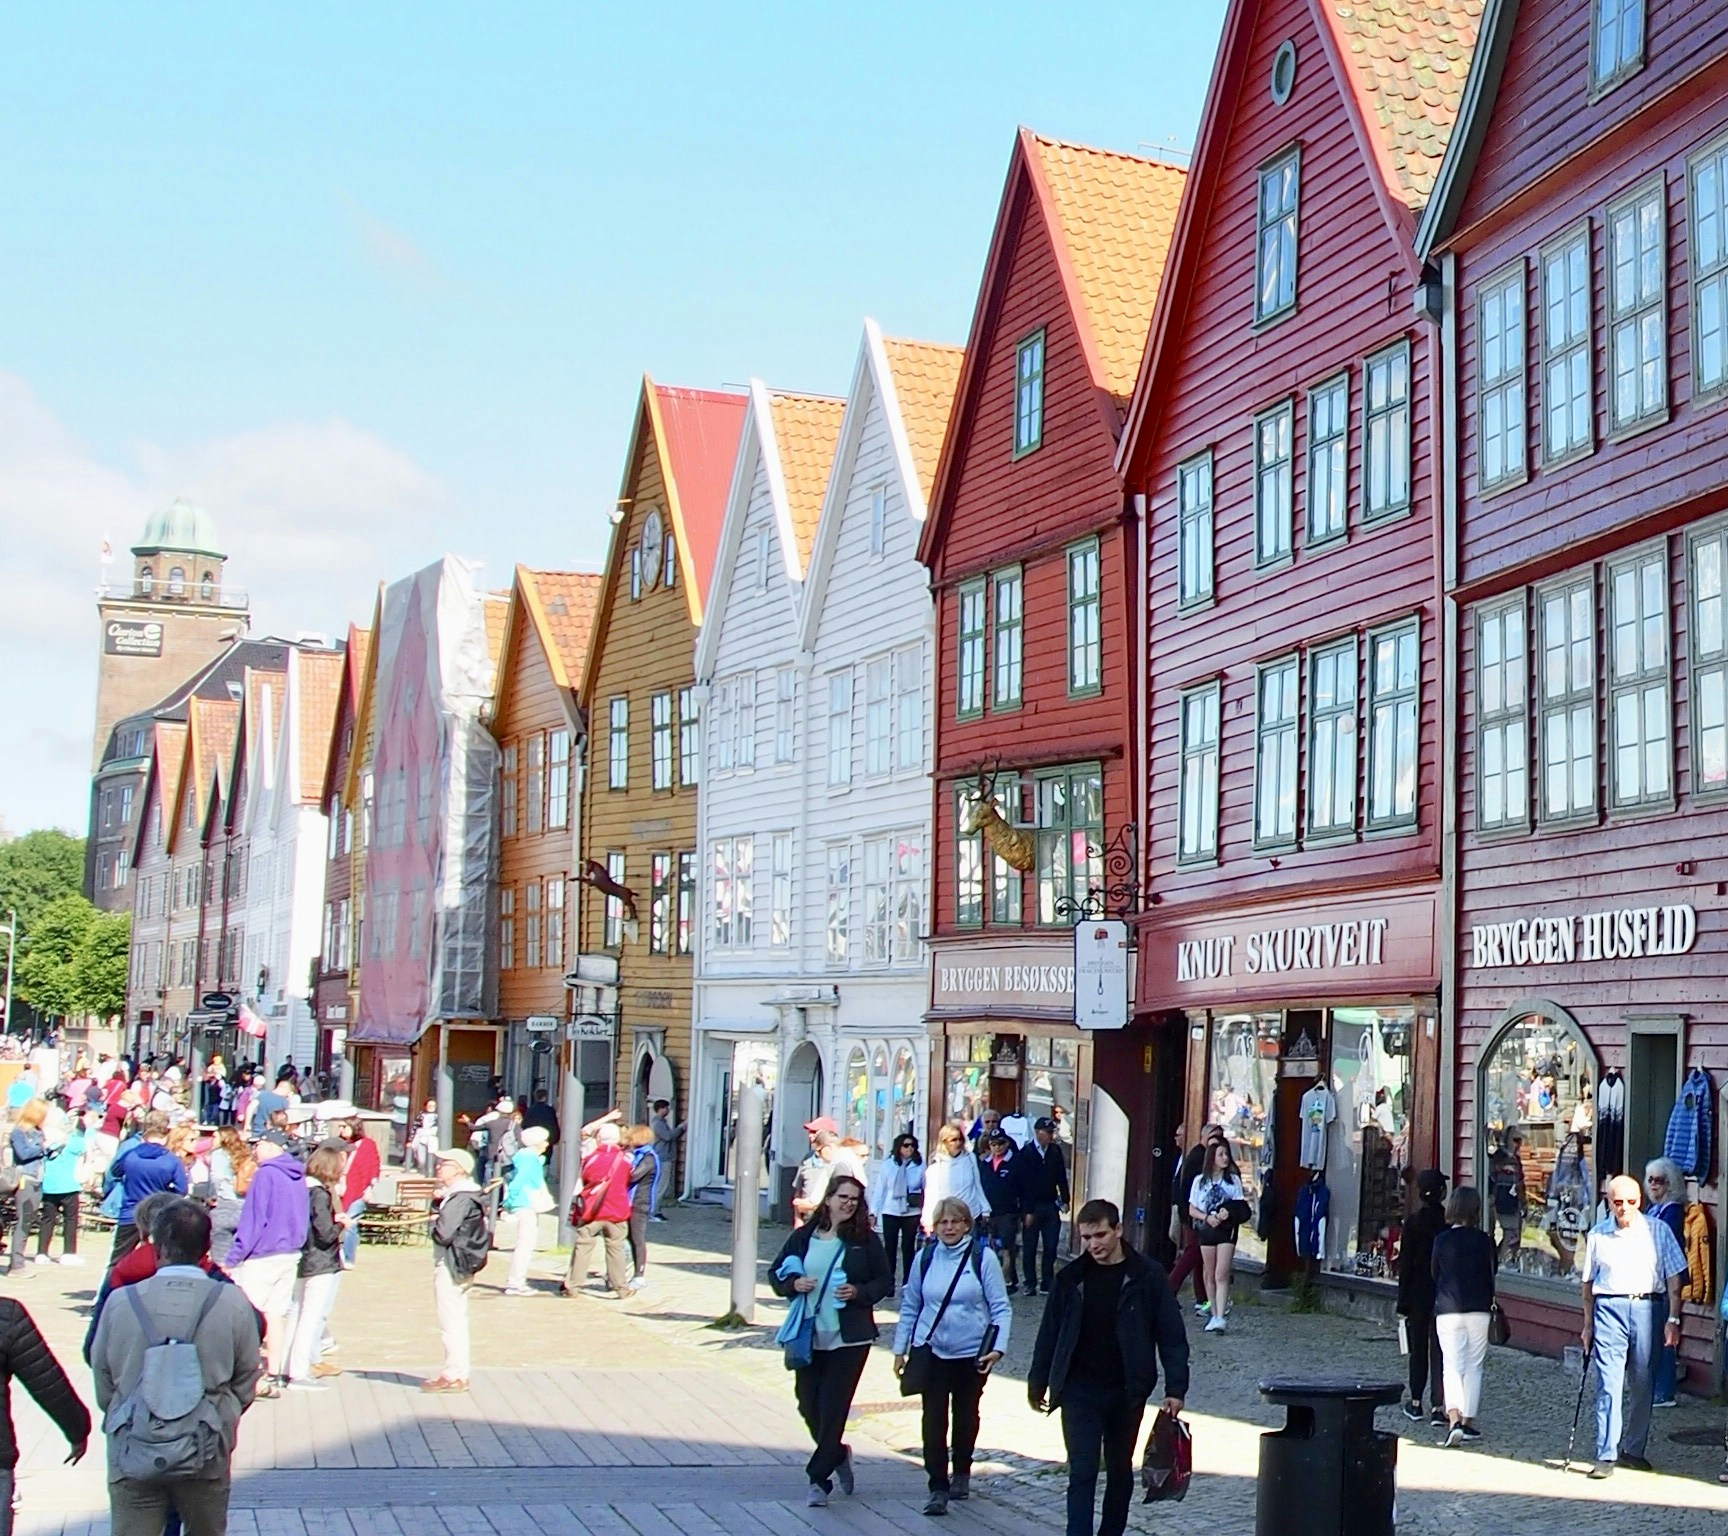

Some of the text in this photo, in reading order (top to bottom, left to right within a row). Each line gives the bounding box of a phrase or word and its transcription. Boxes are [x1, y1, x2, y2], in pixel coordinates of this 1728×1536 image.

[1176, 918, 1387, 982] KNUT SKURTVEIT
[1472, 904, 1697, 968] BRYGGEN HUSFLID
[941, 967, 1000, 992] BRYGGEN
